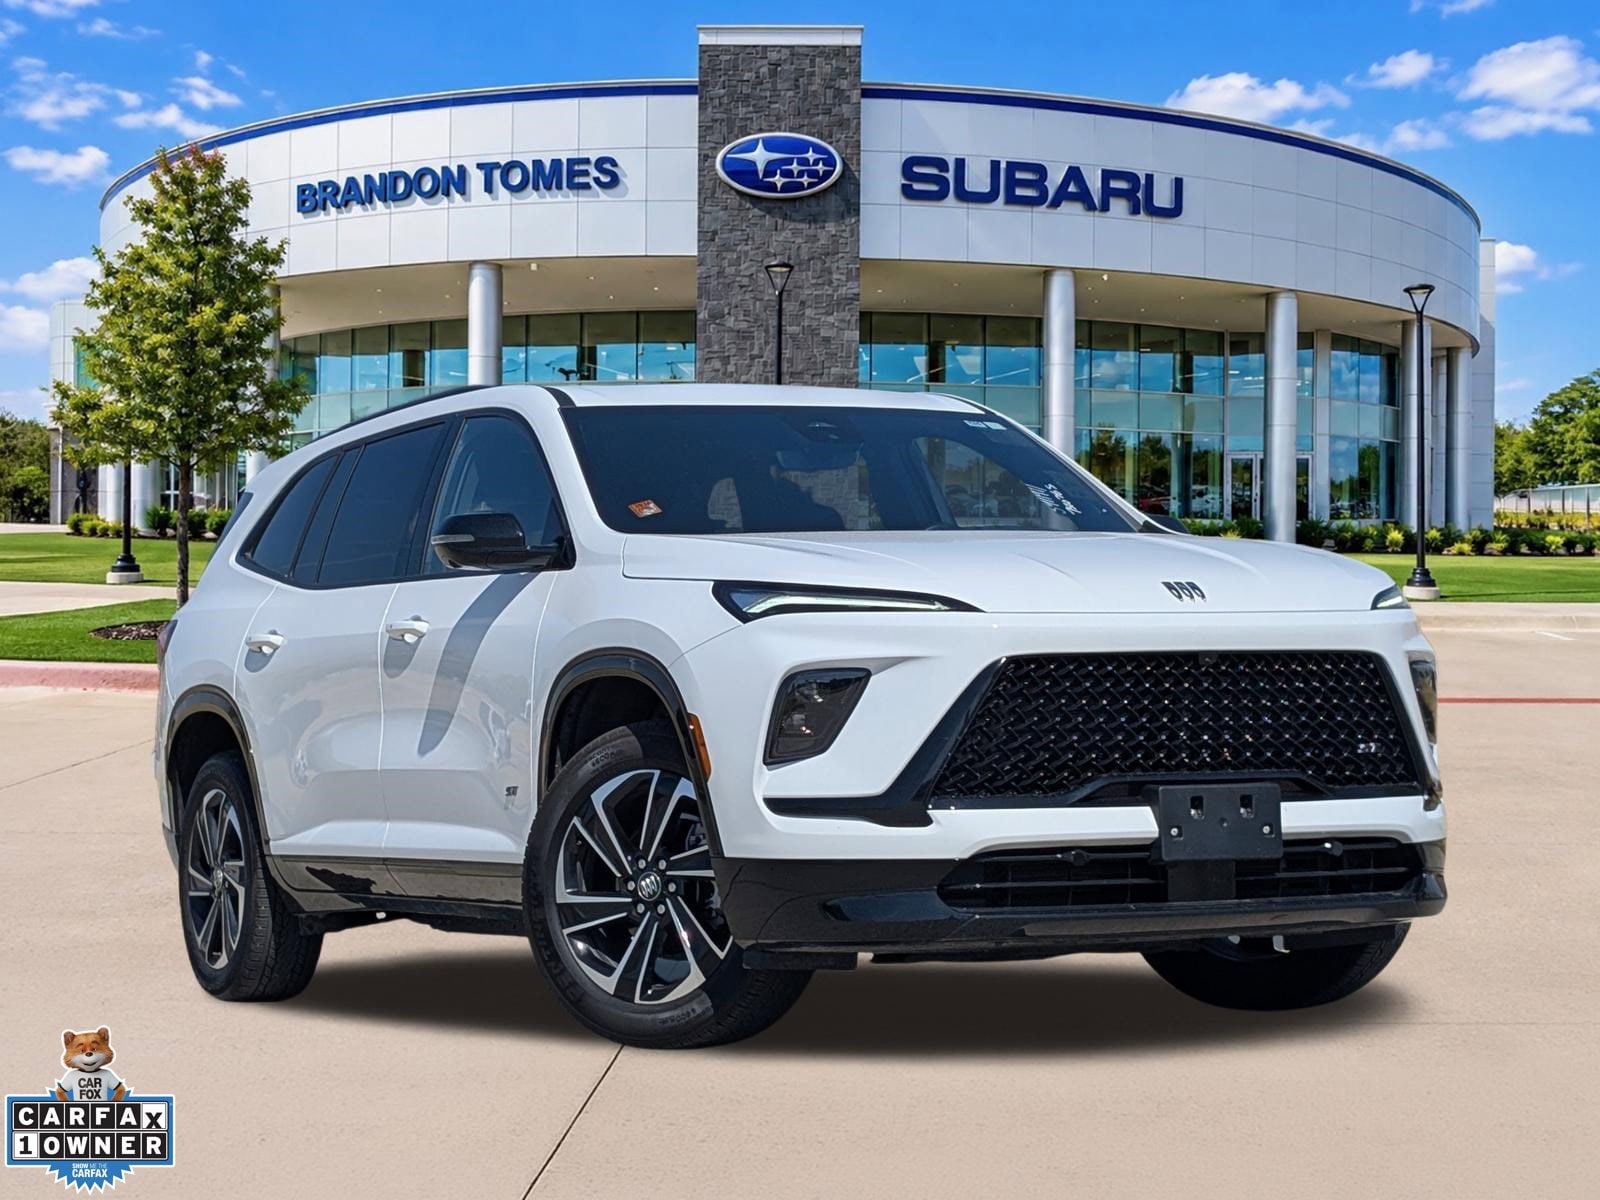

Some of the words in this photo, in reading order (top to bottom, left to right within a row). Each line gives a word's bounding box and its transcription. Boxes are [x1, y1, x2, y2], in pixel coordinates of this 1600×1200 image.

[296, 164, 466, 213] BRANDON
[476, 156, 620, 194] TOMES
[901, 155, 1184, 218] SUBARU
